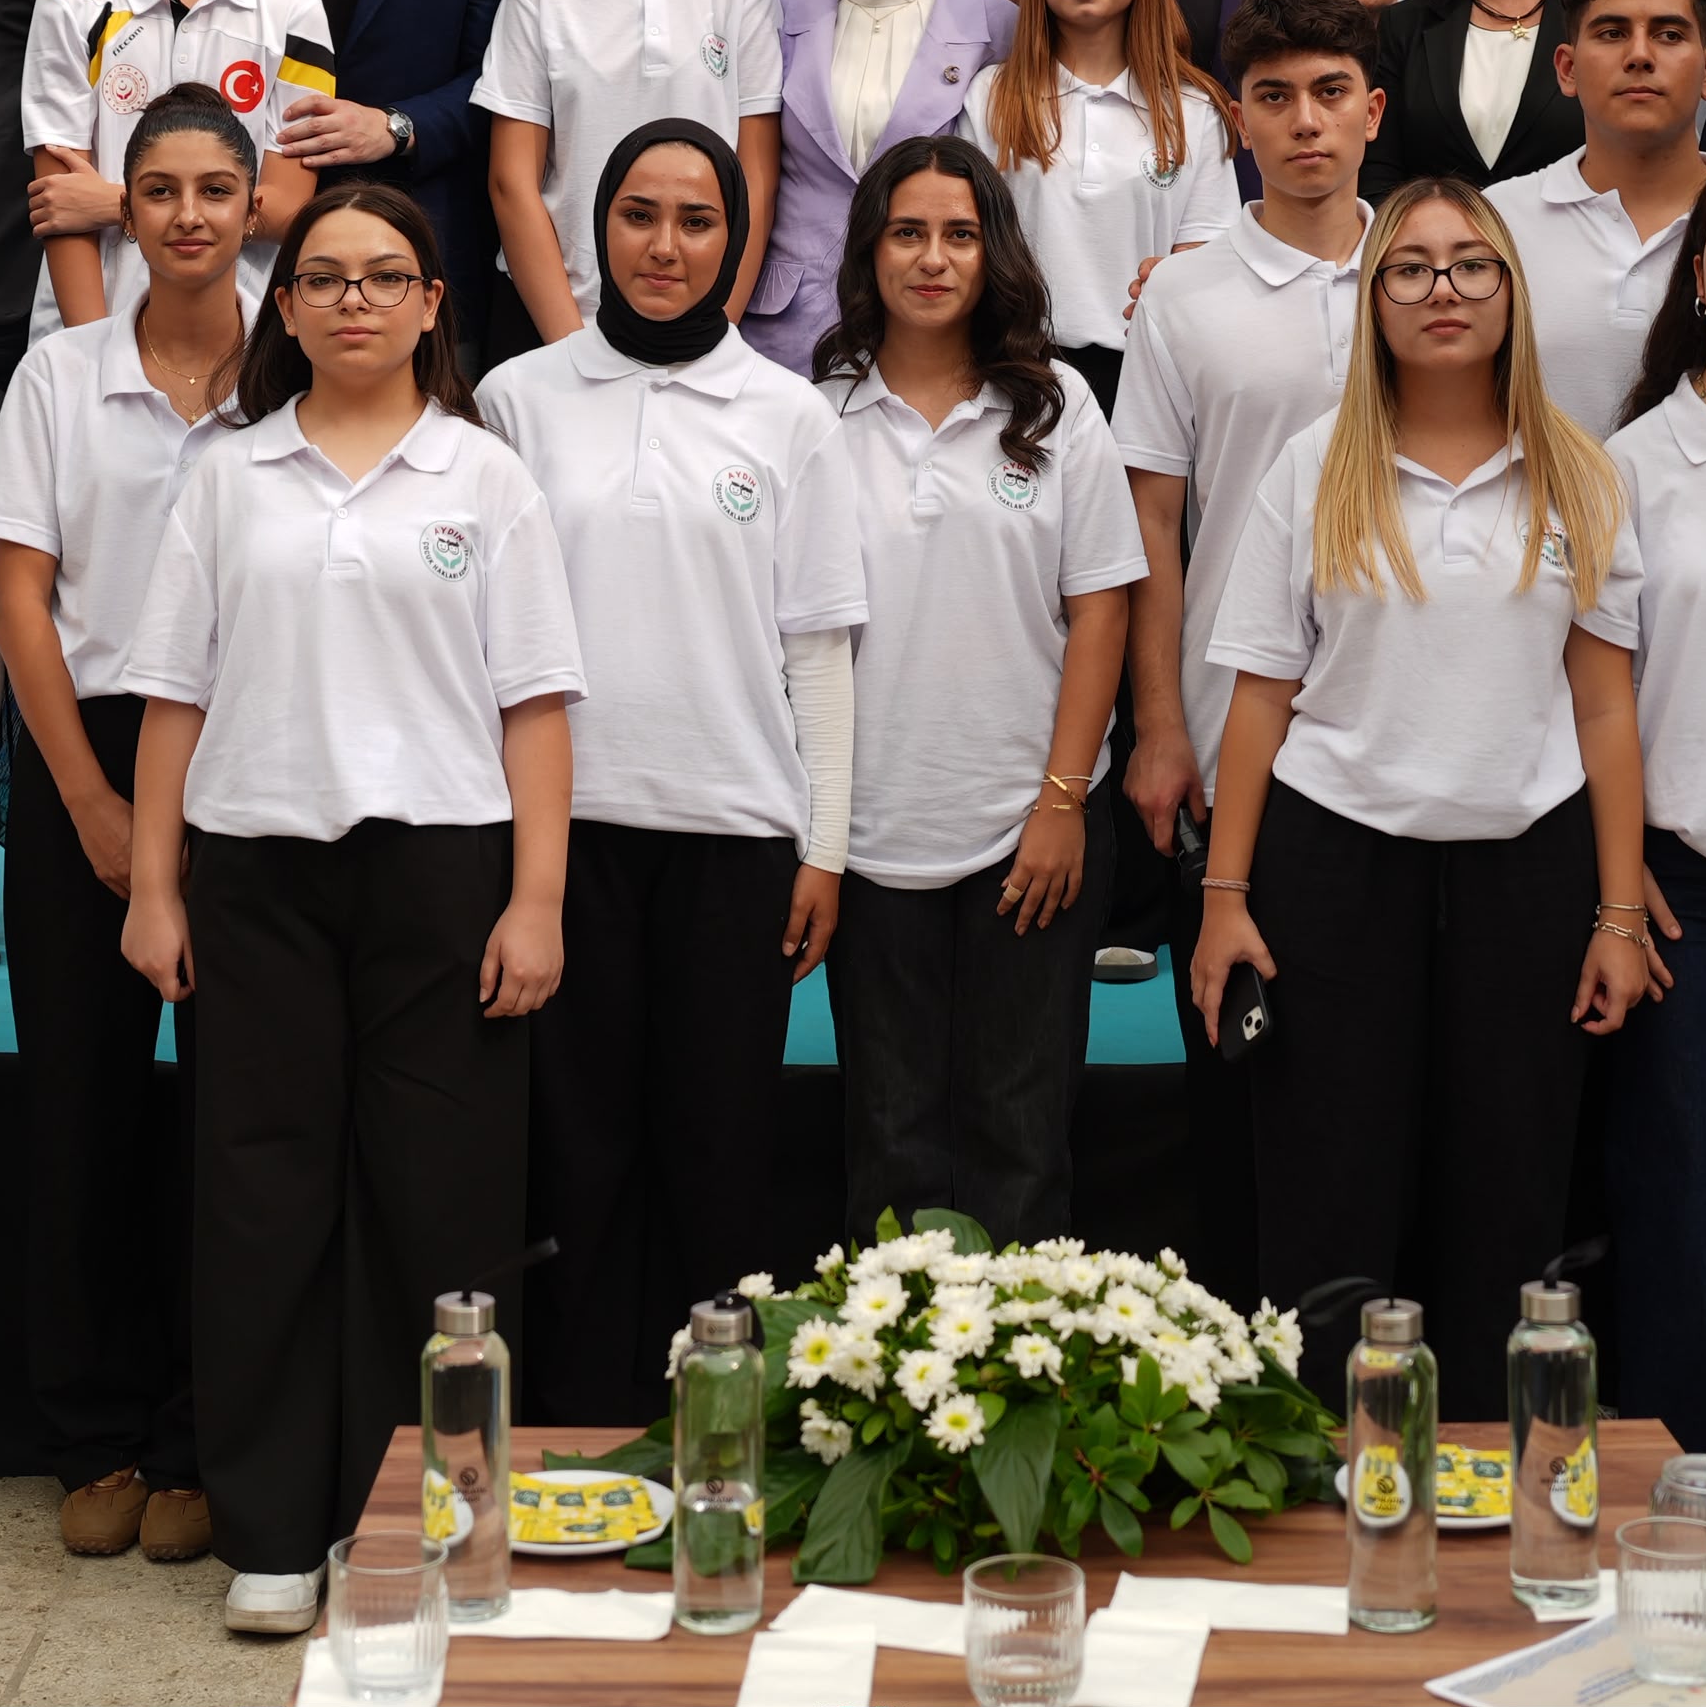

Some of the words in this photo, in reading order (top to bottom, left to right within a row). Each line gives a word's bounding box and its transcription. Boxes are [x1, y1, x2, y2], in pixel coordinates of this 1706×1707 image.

[113, 26, 145, 57] fitcom
[1003, 462, 1031, 476] AYDIN
[728, 471, 757, 488] AYDIN
[434, 526, 465, 542] AYDIN
